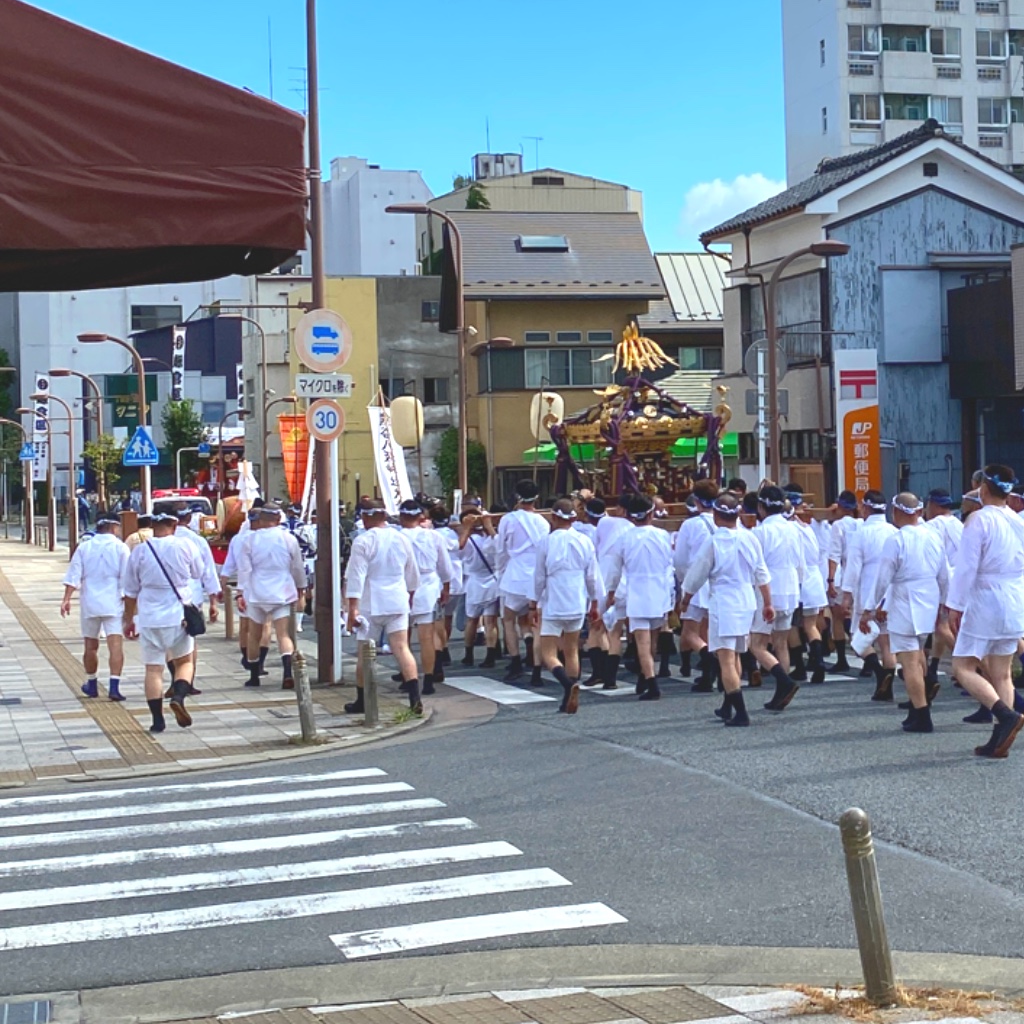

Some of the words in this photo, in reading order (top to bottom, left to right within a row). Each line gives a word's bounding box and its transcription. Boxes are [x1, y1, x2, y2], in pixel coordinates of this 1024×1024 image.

[299, 379, 349, 393] マイクロを除く
[315, 411, 337, 429] 30
[853, 443, 869, 493] 郵便局
